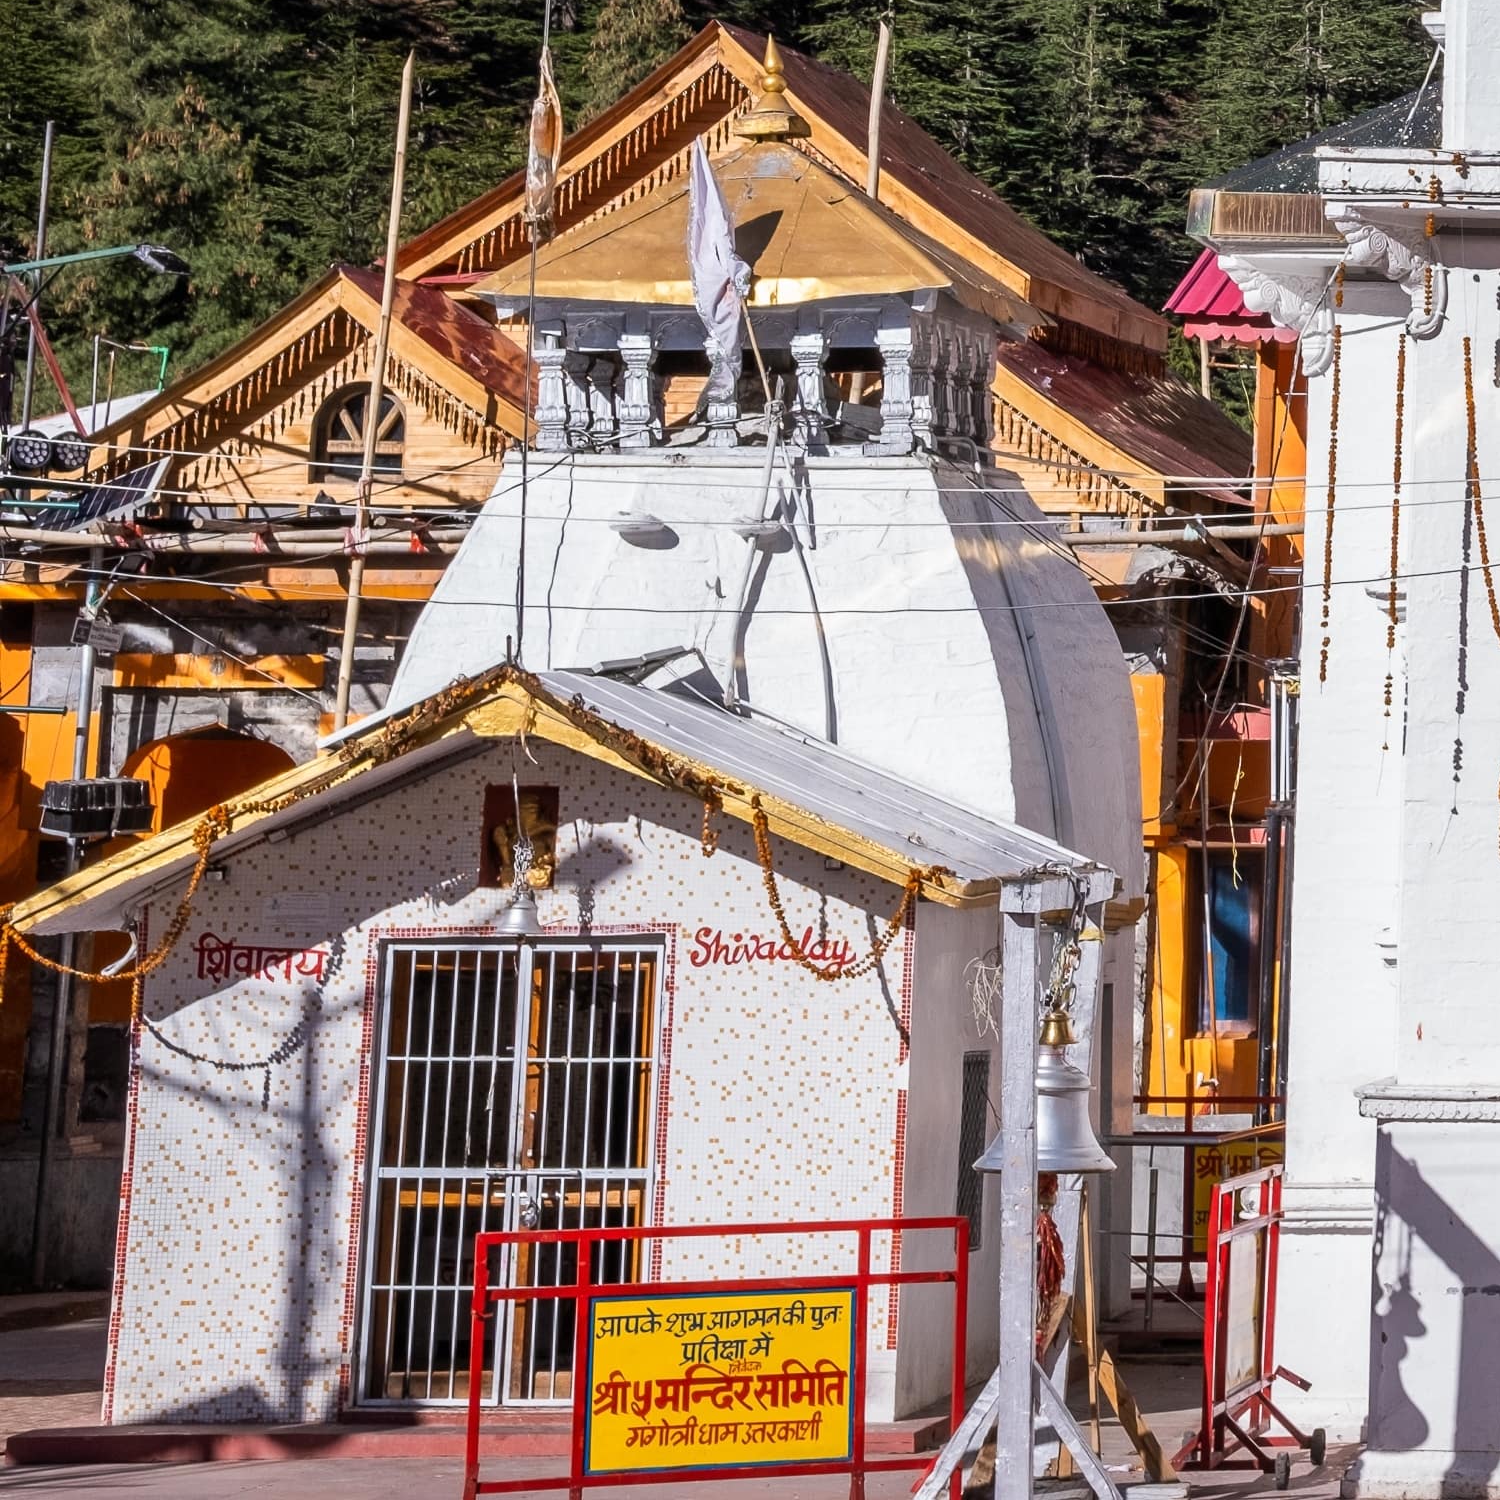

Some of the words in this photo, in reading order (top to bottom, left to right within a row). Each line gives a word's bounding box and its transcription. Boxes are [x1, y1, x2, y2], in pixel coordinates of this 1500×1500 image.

[193, 932, 331, 984] शिवालय
[596, 1308, 662, 1339] आपके
[666, 1311, 706, 1337] शुभ
[707, 1306, 782, 1330] आगमन
[782, 1300, 805, 1326] की
[678, 1333, 747, 1366] प्रतिक्षा
[749, 1332, 774, 1357] में
[593, 1370, 630, 1416] श्री
[656, 1363, 754, 1412] मन्दिर
[754, 1358, 848, 1411] समिति
[626, 1411, 698, 1448] गंगोत्री
[699, 1422, 744, 1446] धाम
